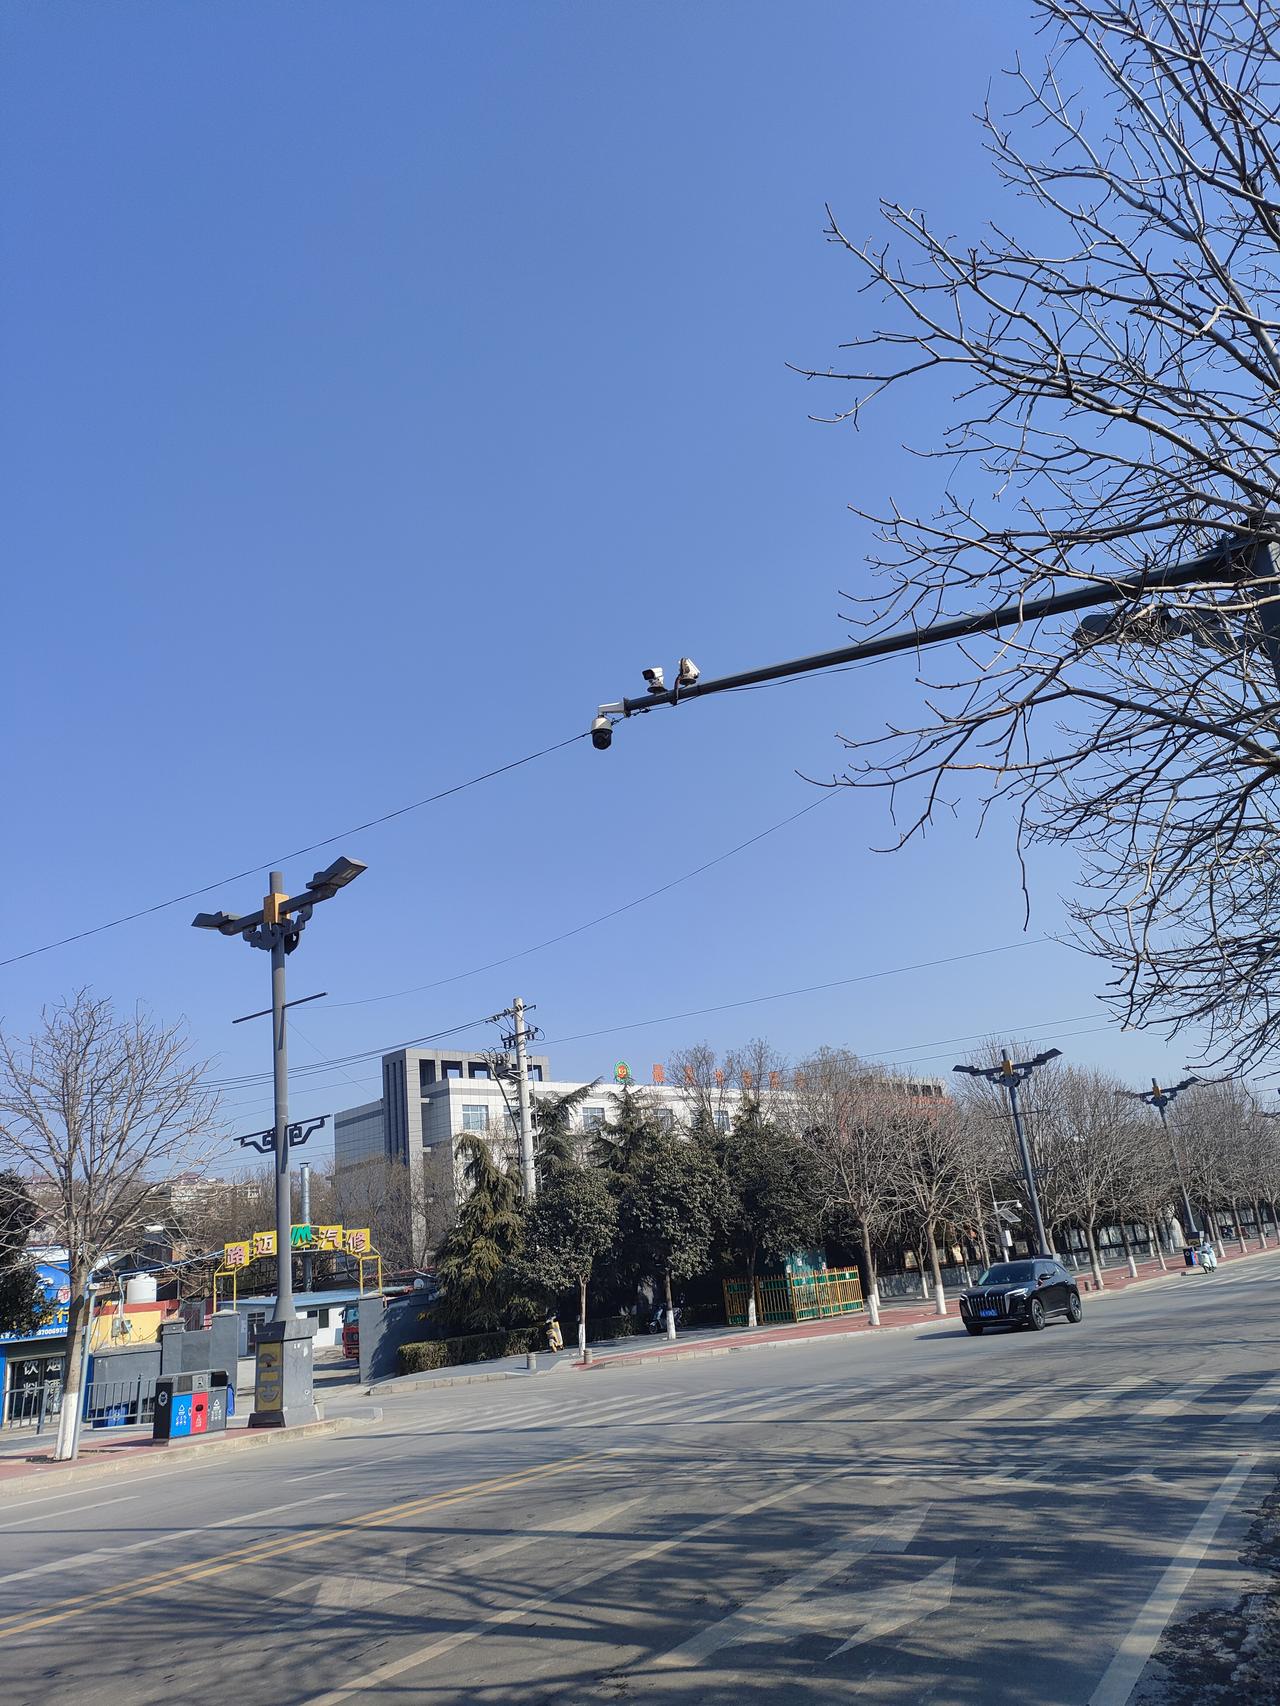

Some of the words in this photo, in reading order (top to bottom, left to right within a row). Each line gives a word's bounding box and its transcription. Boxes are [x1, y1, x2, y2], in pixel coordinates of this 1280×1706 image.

[226, 1234, 275, 1266] 路迈
[320, 1229, 367, 1252] 汽修
[22, 1360, 39, 1398] 饮料
